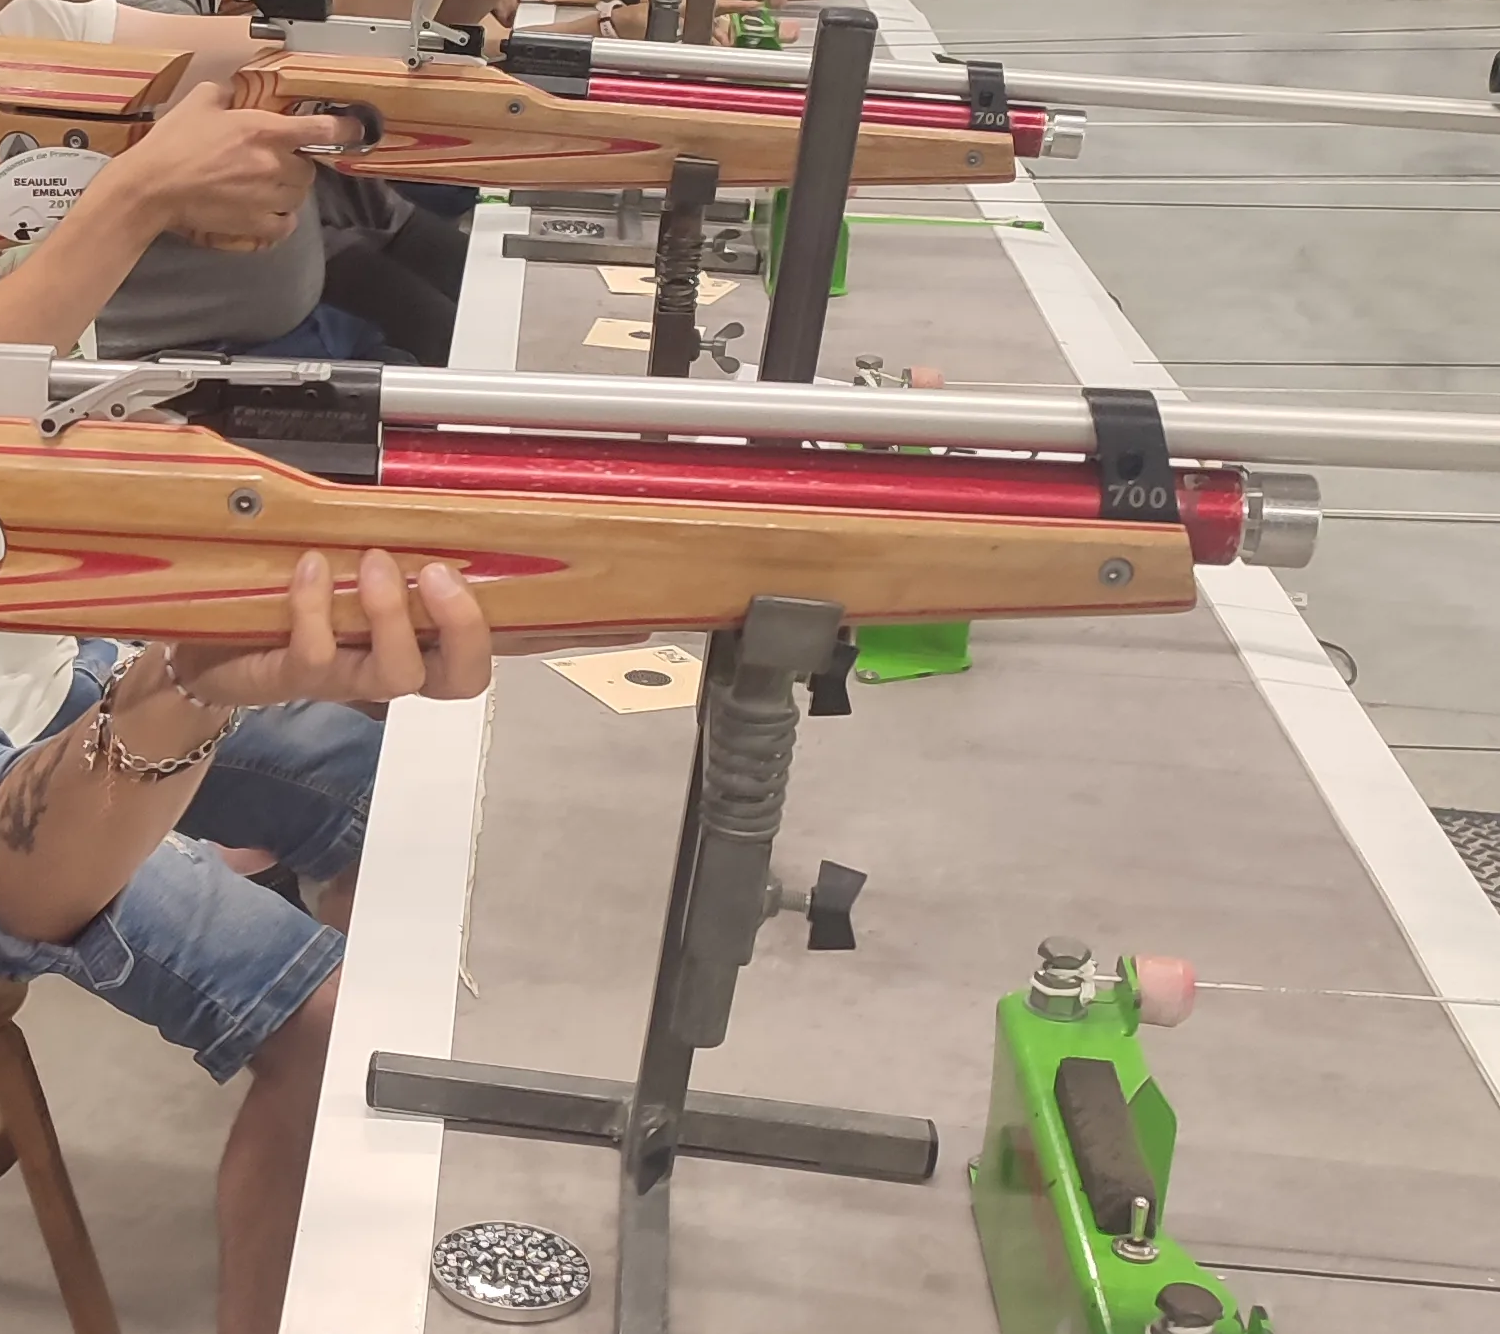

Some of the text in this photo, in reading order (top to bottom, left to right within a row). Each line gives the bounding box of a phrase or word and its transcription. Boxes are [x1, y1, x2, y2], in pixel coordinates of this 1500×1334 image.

[974, 111, 1006, 126] 700
[13, 178, 67, 187] BEAULIEU
[33, 188, 85, 197] EMBLAV
[1108, 484, 1167, 509] 700
